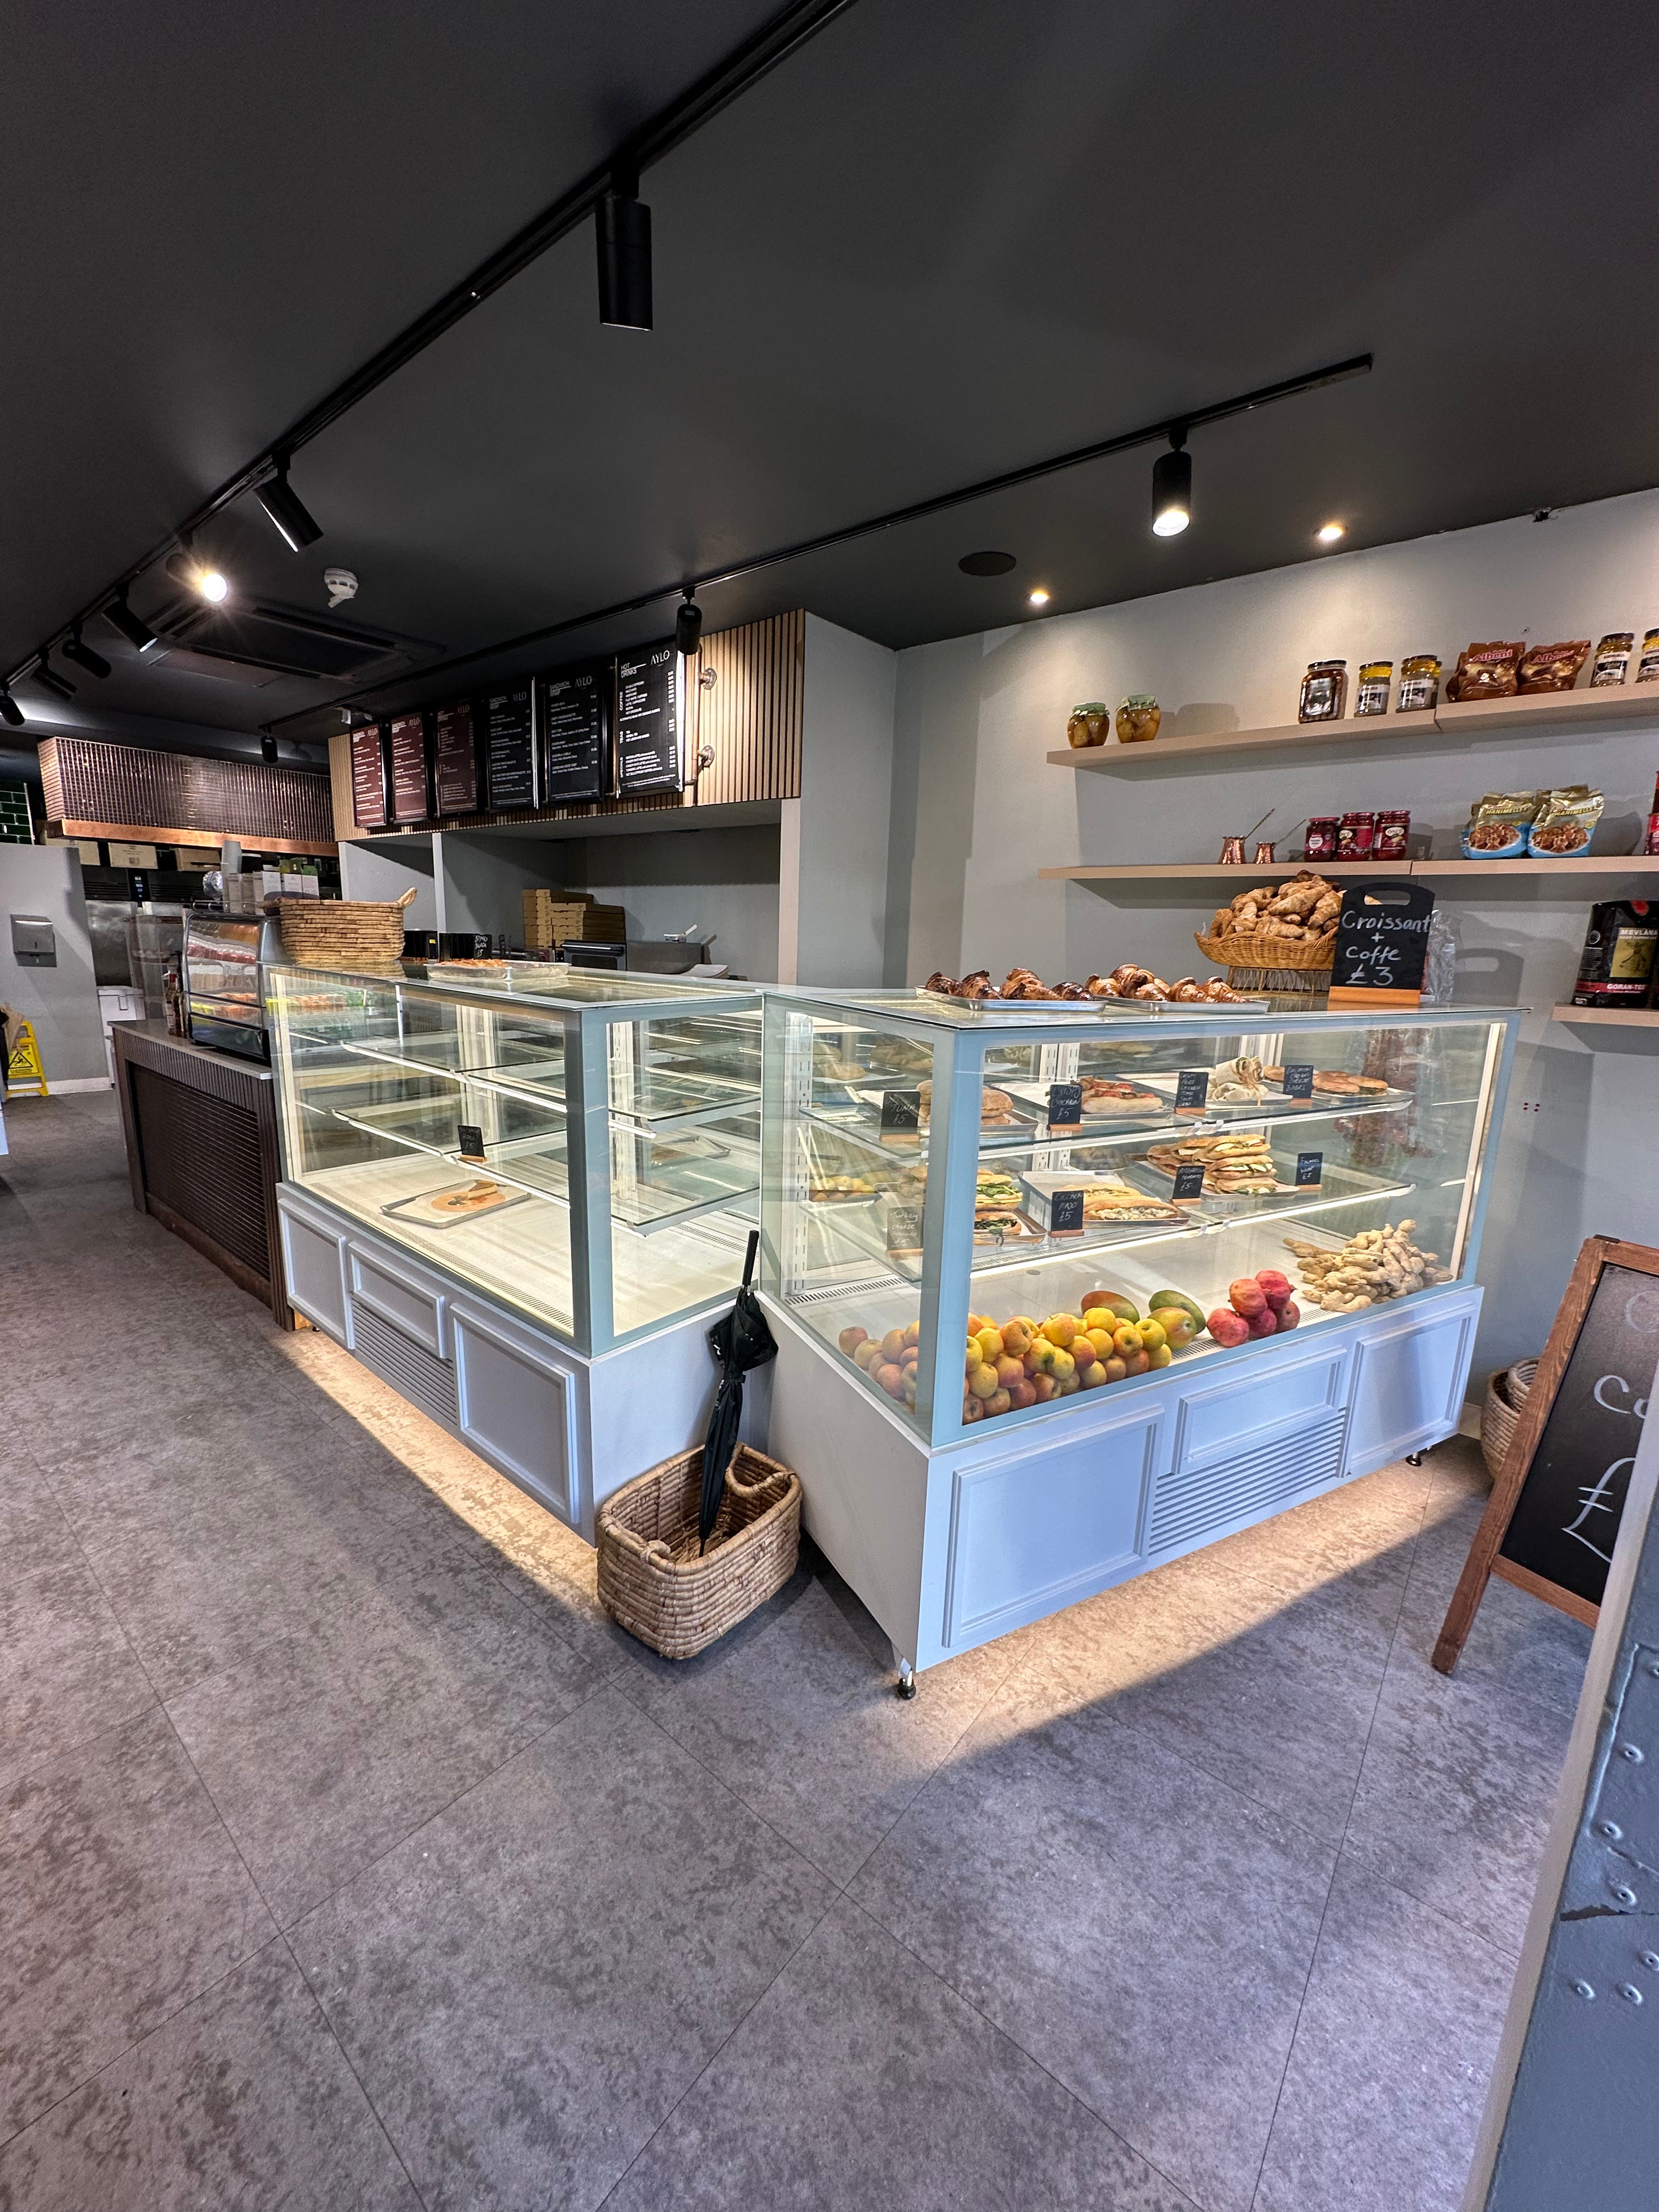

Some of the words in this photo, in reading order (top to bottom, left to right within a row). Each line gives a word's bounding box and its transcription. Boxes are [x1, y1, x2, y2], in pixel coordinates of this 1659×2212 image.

[1341, 910, 1432, 933] Croissant
[890, 1104, 916, 1112] TUNA
[1058, 1211, 1075, 1222] £5
